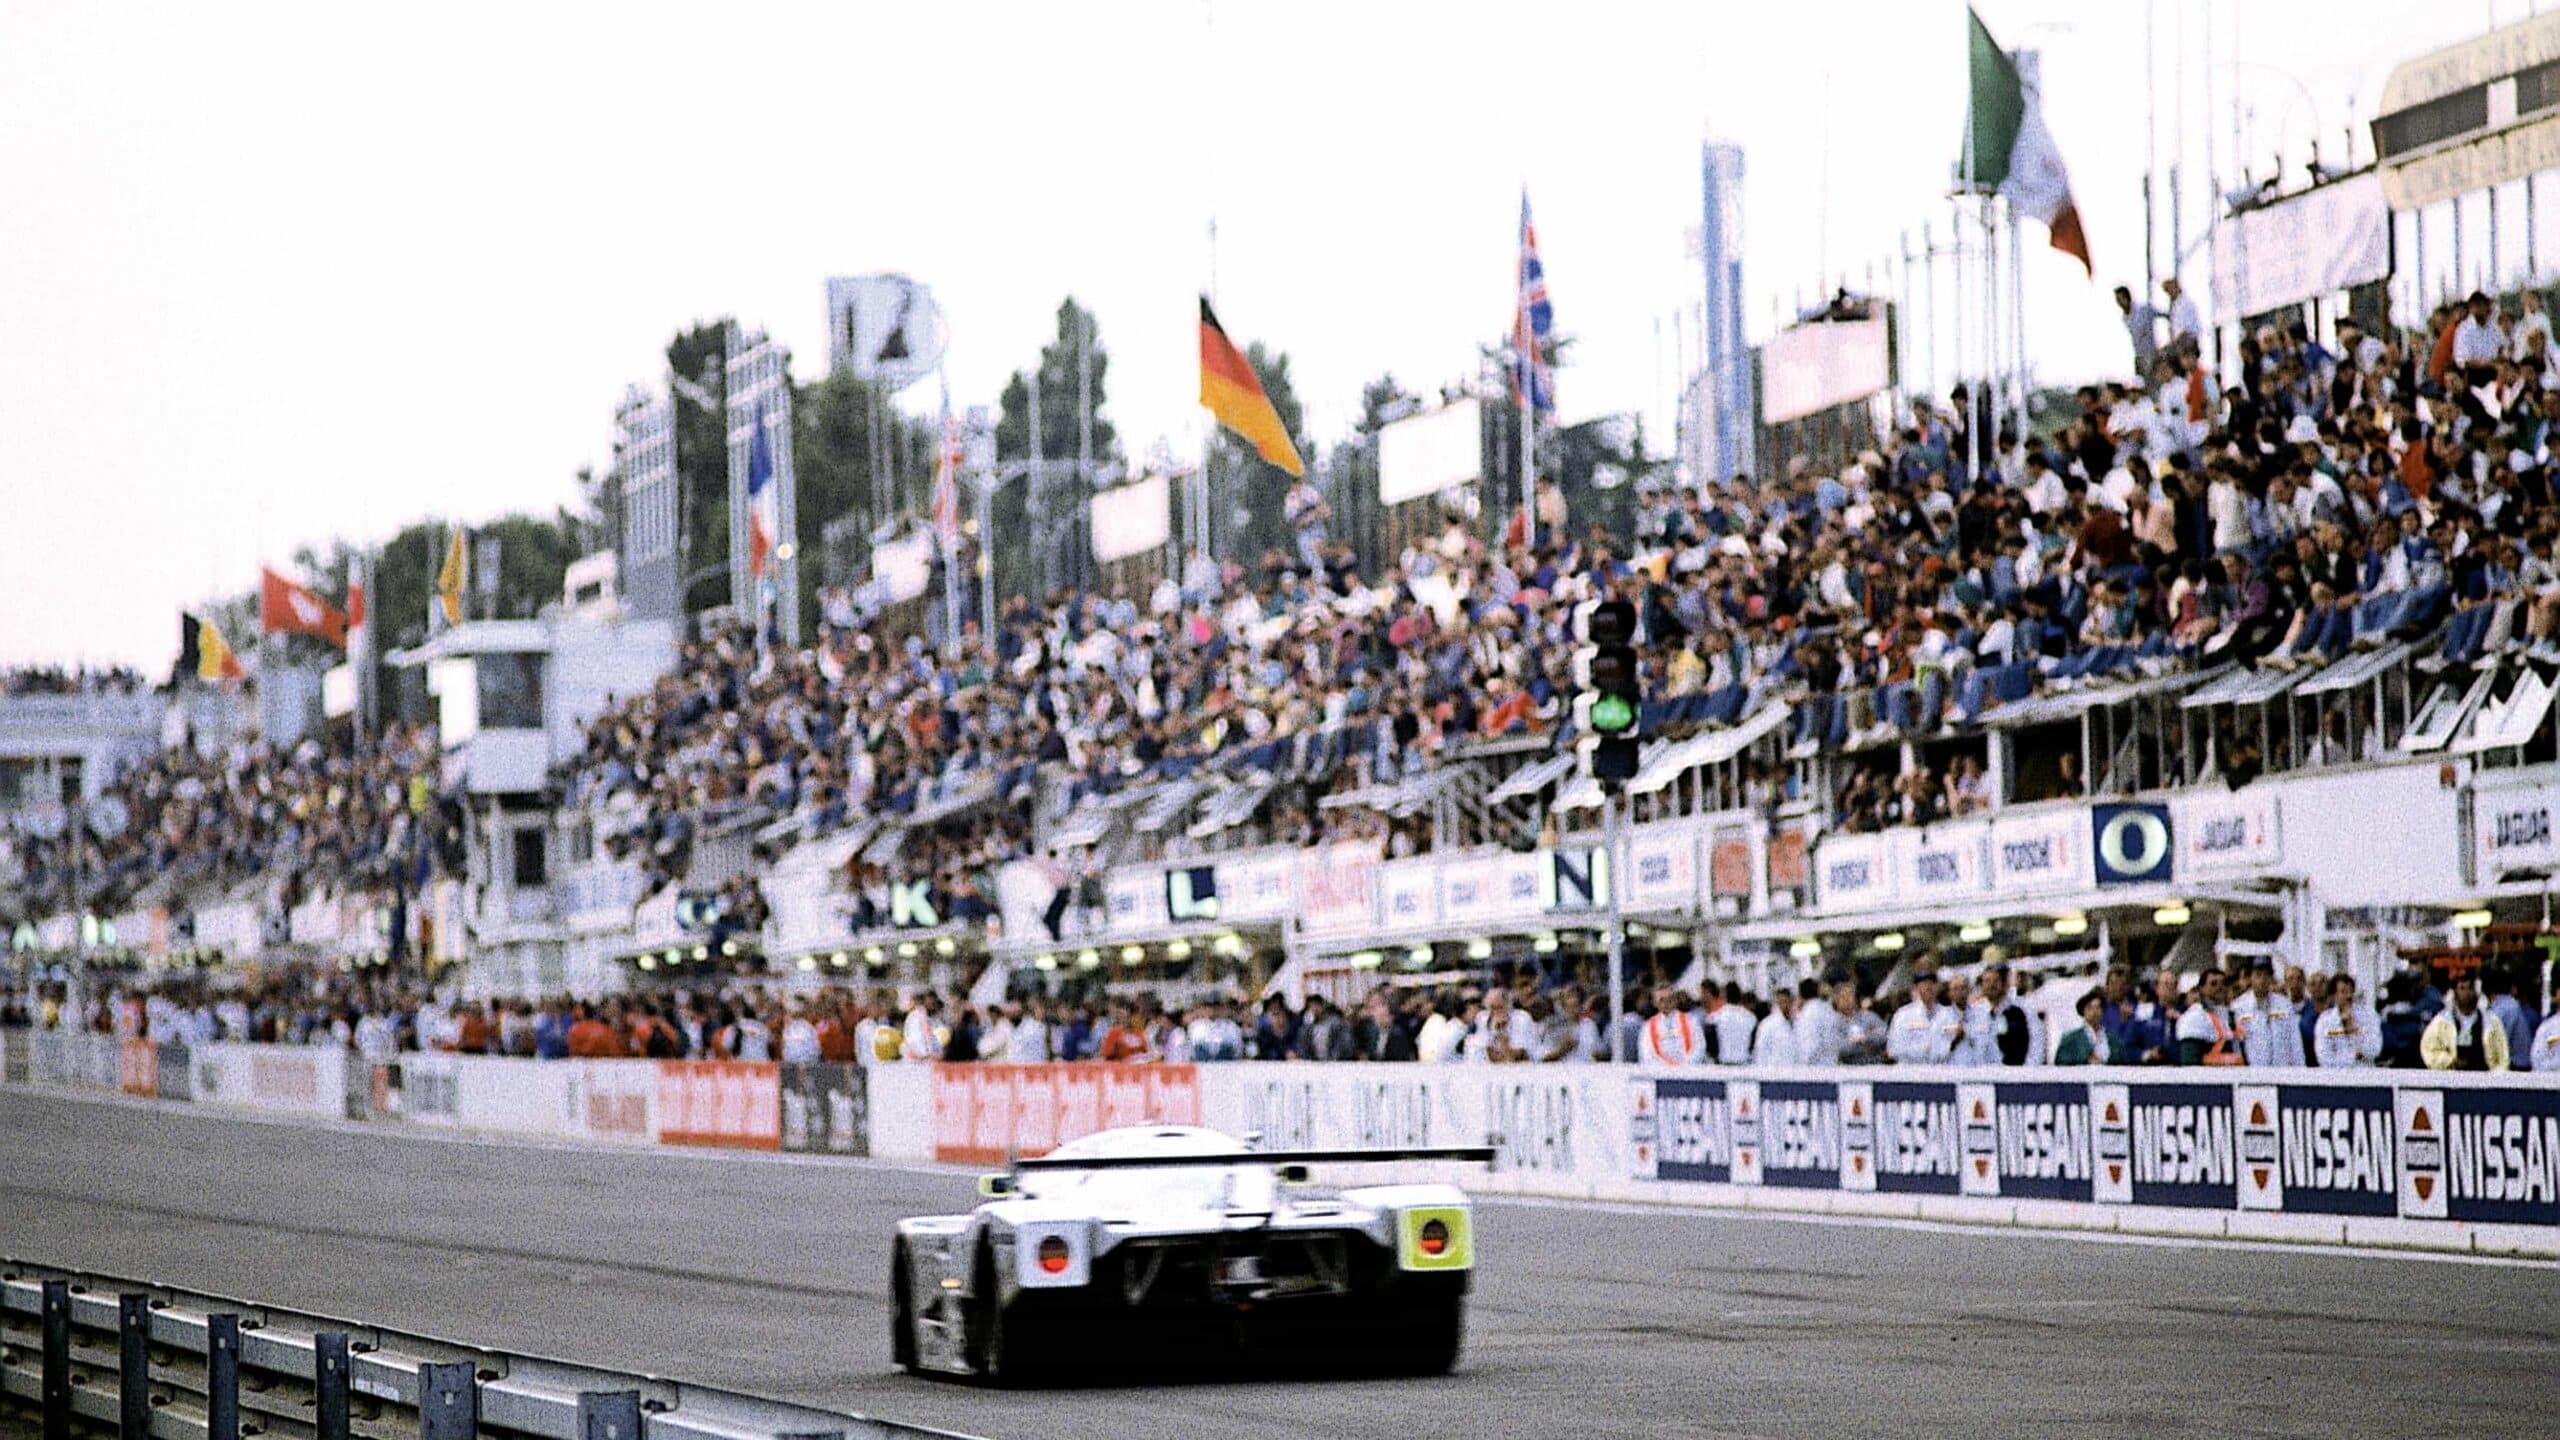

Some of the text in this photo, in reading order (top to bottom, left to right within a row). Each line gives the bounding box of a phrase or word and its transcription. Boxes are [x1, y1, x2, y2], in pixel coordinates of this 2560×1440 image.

[1550, 850, 1597, 906] N
[2101, 810, 2167, 875] O
[890, 879, 938, 926] K
[1170, 872, 1219, 918] L
[1763, 1099, 1839, 1171] NISSAN
[1876, 1101, 1959, 1176] NISSAN
[1998, 1103, 2091, 1181] NISSAN
[2133, 1104, 2234, 1185] NISSAN
[2281, 1107, 2394, 1193] NISSAN
